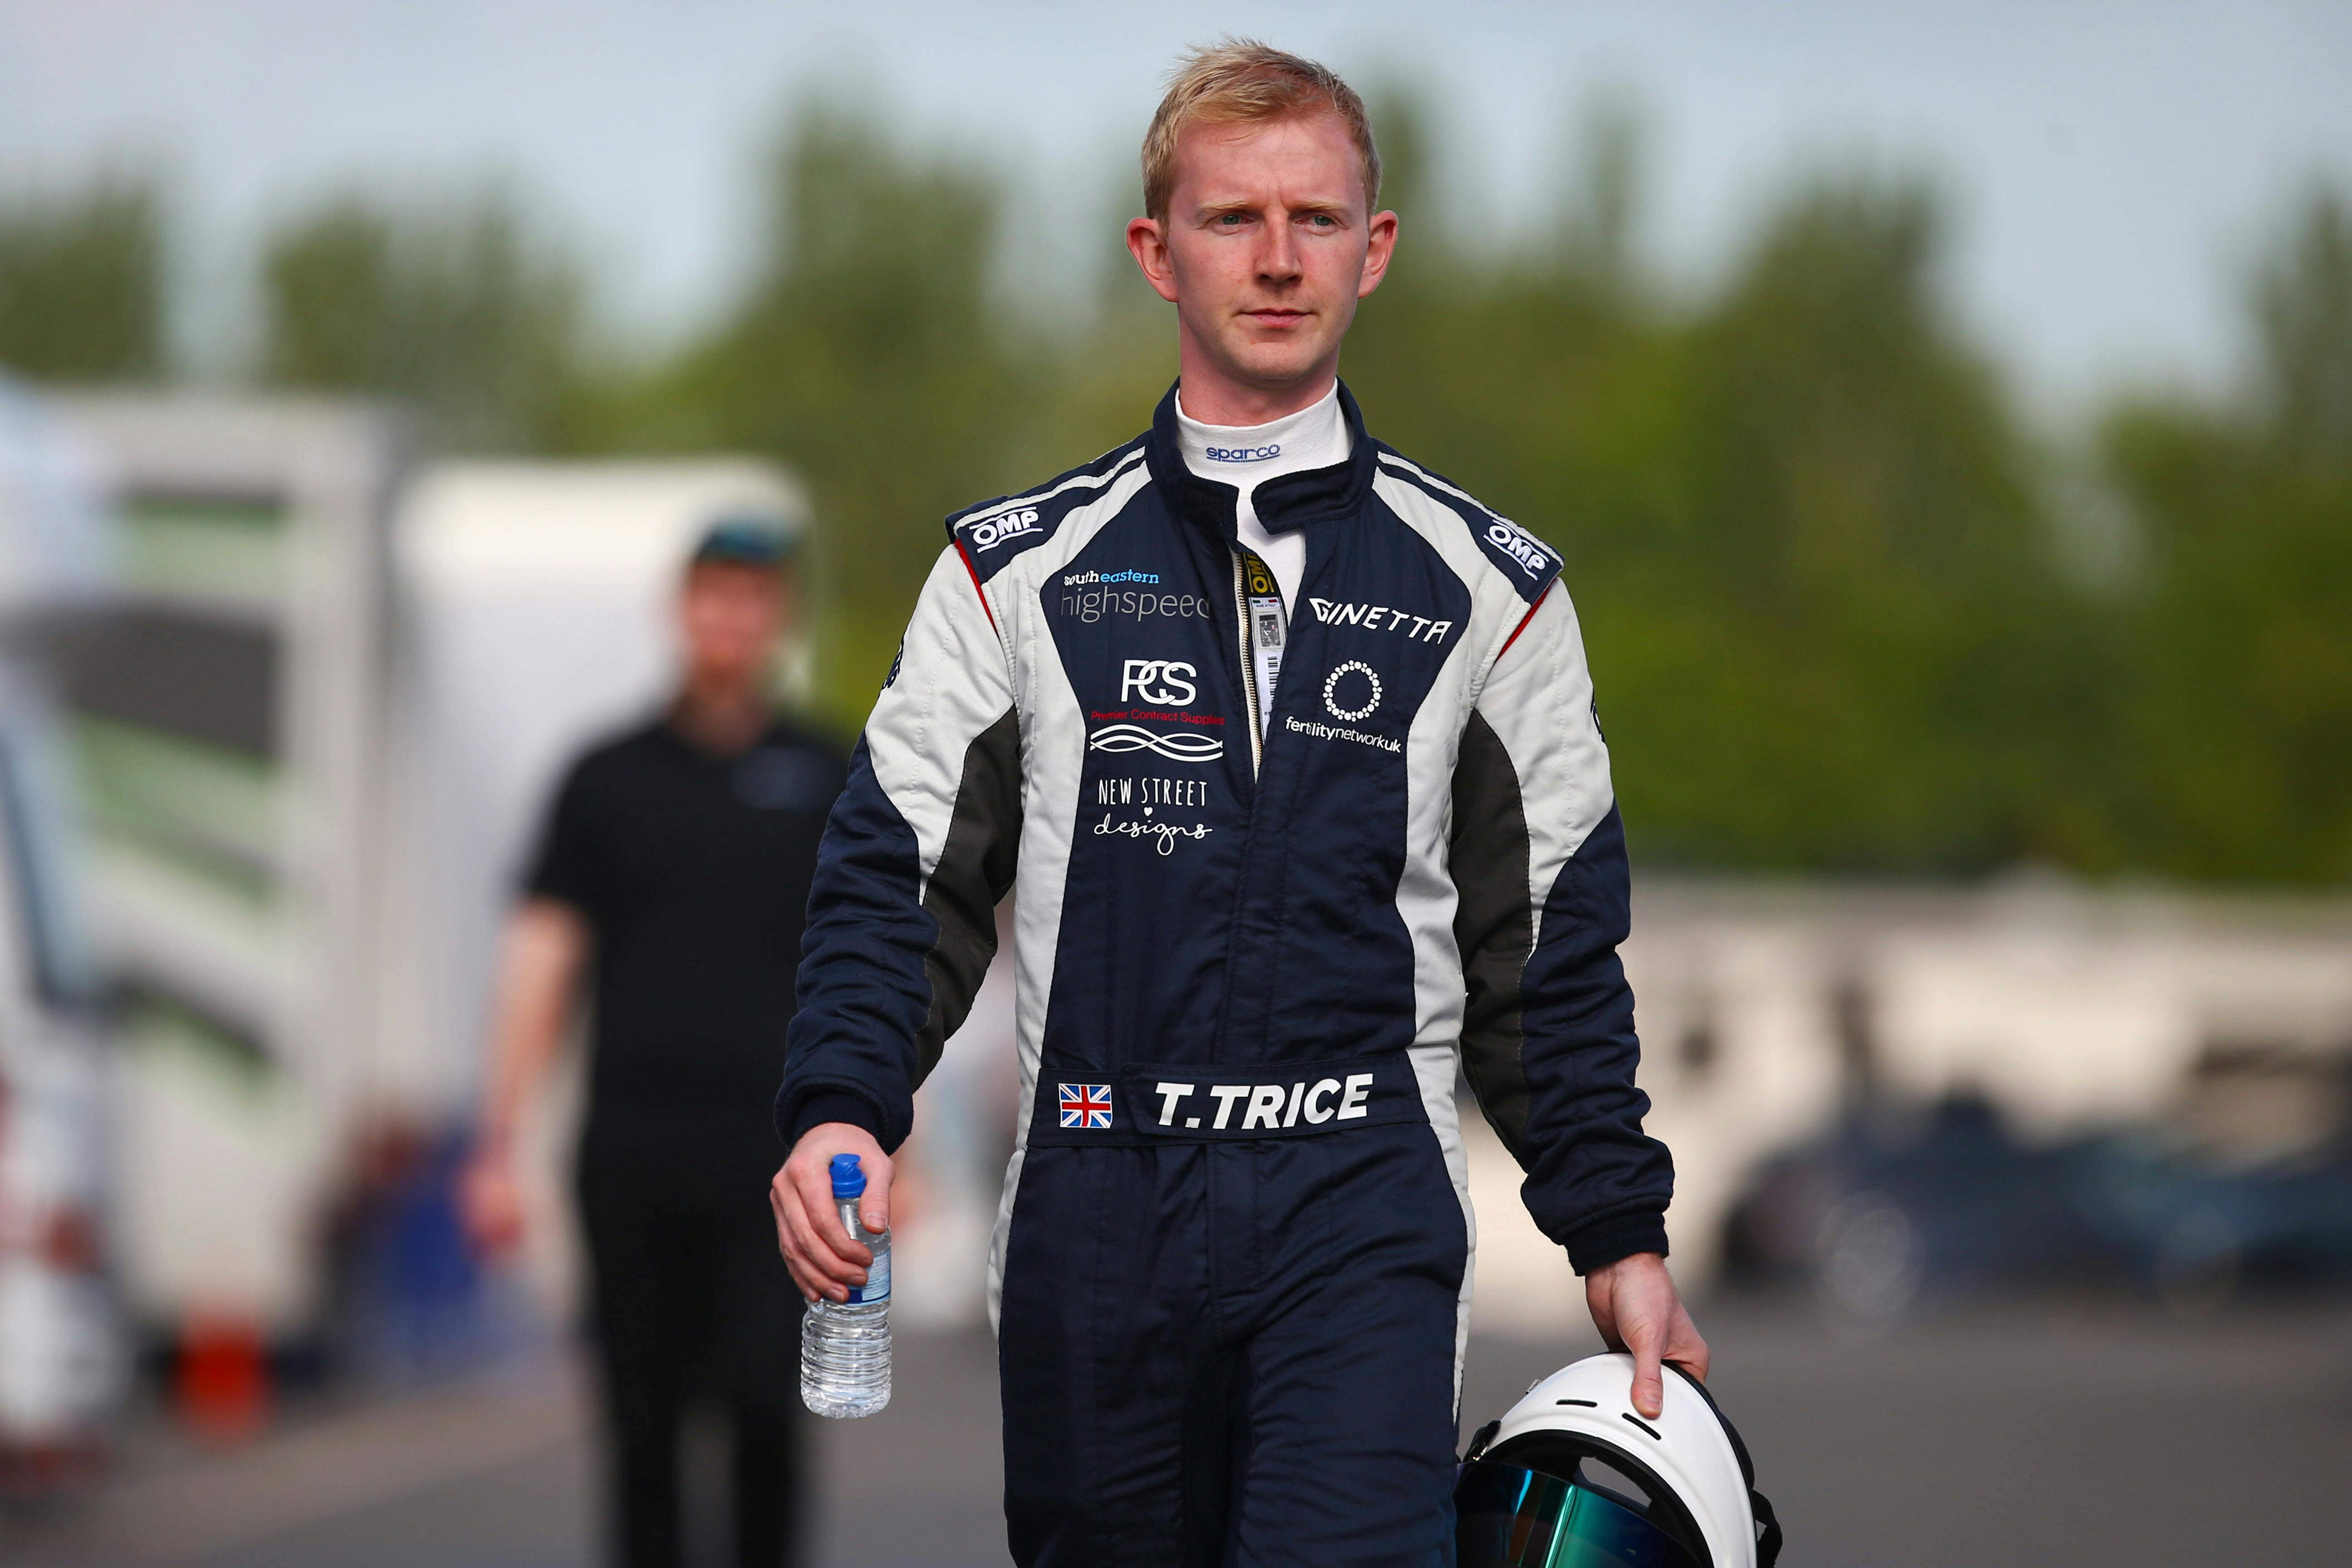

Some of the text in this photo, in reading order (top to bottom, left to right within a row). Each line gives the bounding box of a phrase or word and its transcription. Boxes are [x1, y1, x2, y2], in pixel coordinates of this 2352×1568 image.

[1206, 444, 1280, 462] sparco
[973, 511, 1039, 544] OMP
[1489, 525, 1546, 570] OMP
[1063, 569, 1159, 586] southeastern
[1309, 598, 1453, 644] GINETTA
[1121, 660, 1197, 706] PCS
[1091, 709, 1225, 725] Premier Contract Supplies
[1286, 716, 1401, 753] fertilitynetworkuk
[1098, 778, 1207, 806] NEW STREET
[1094, 813, 1213, 855] designs
